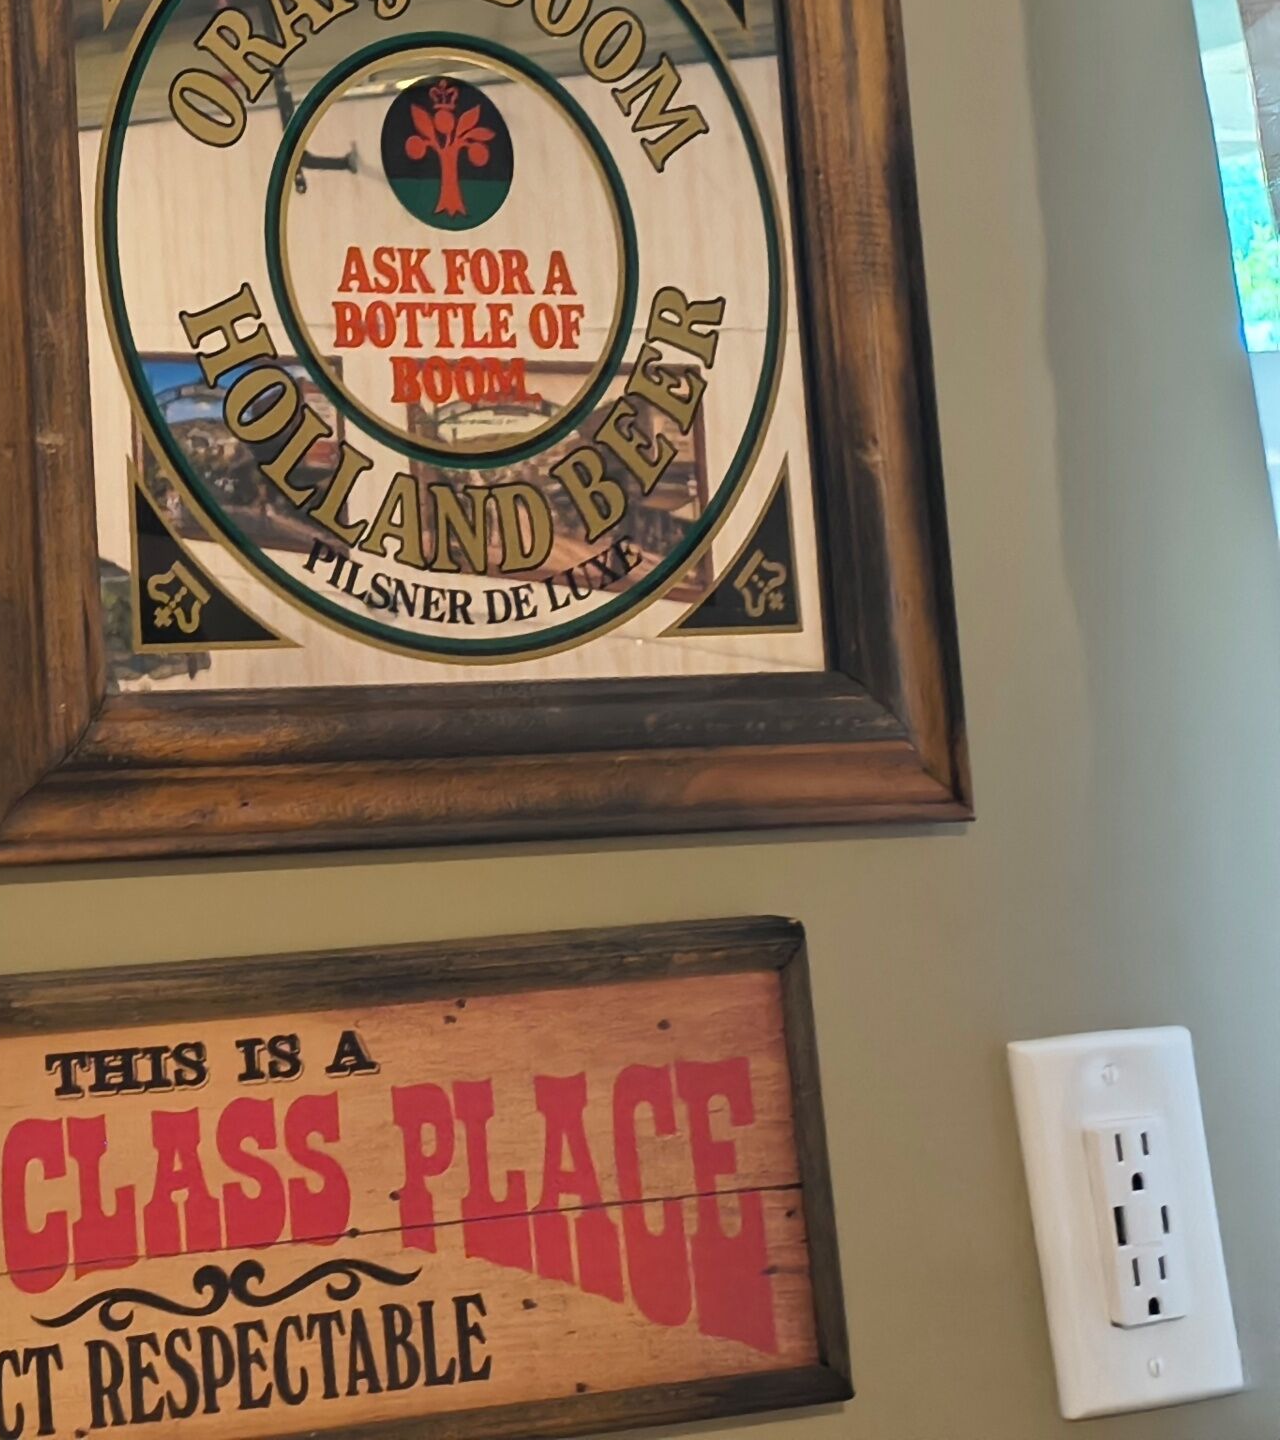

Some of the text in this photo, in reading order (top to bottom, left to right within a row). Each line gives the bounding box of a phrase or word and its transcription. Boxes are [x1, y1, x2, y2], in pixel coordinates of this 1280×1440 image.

[338, 246, 577, 295] ASK FOR A
[332, 300, 585, 349] BOTTLE OF
[179, 282, 726, 575] HOLLAND BEER
[302, 535, 643, 626] PILSNER DE LUXE
[44, 1030, 380, 1099] THIS IS A
[1, 1092, 351, 1295] CLASS
[390, 1055, 780, 1355] PLACE
[82, 1292, 493, 1432] RESPECTABLE
